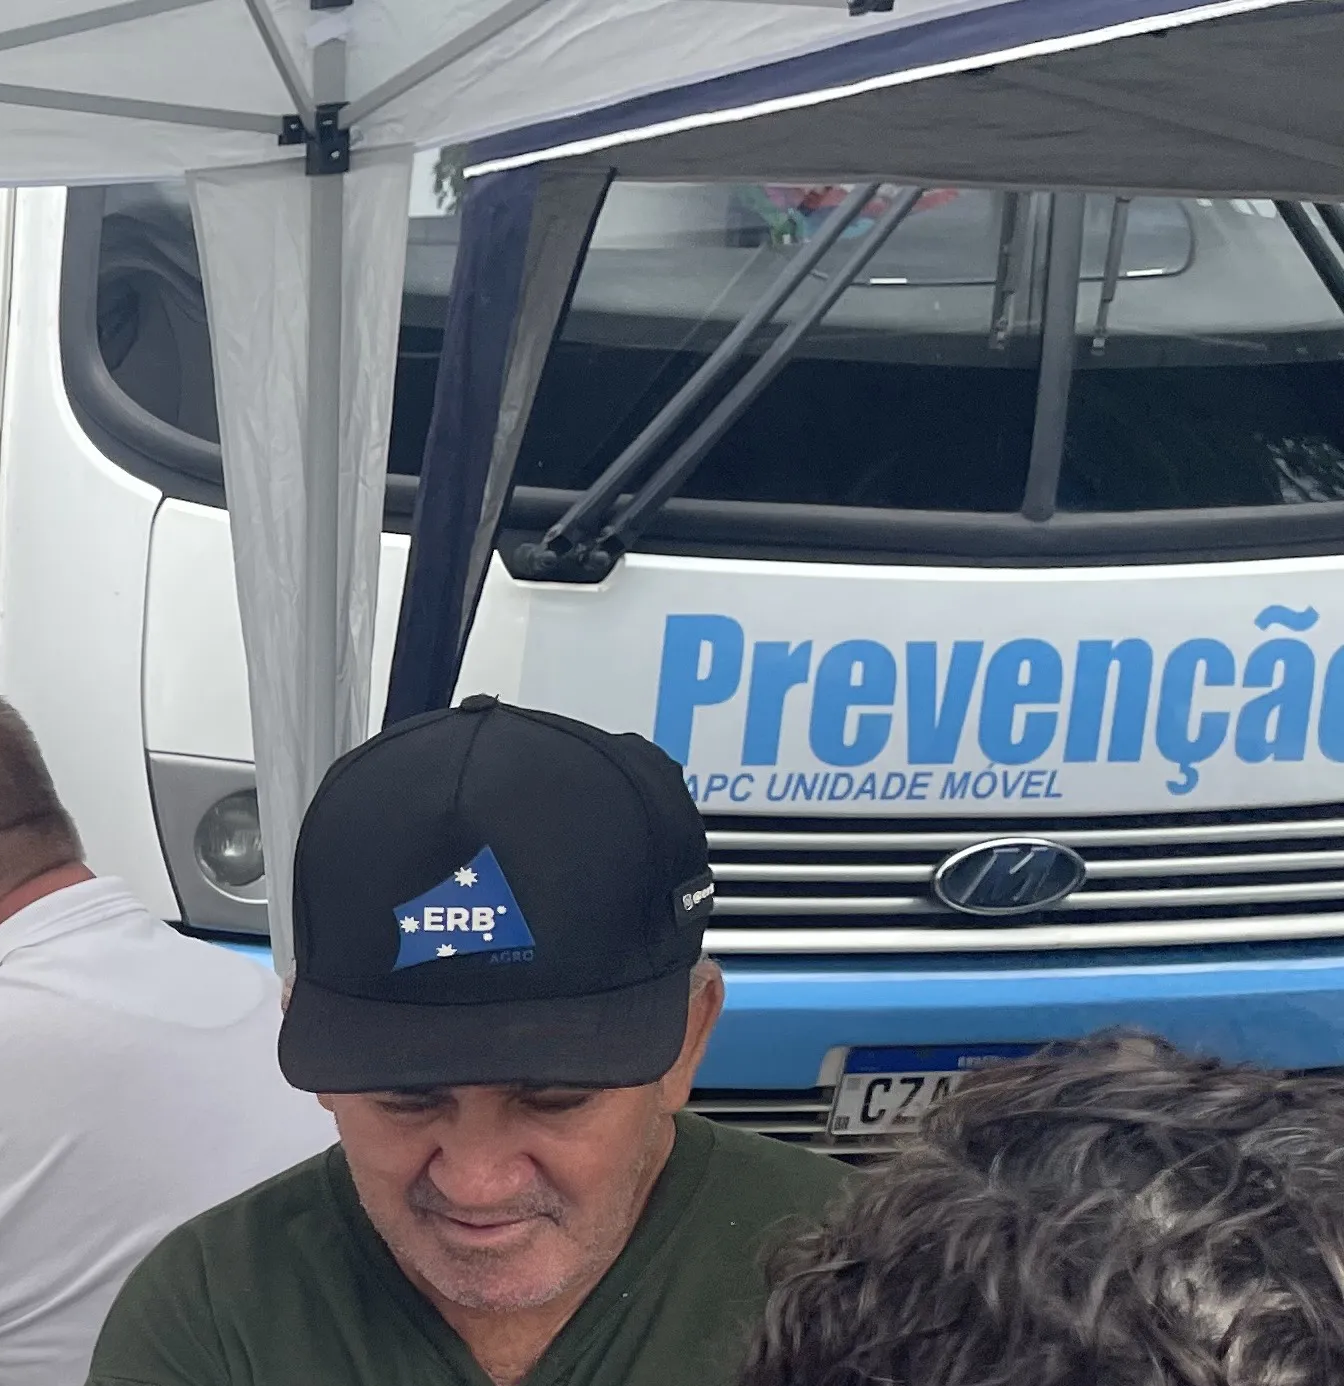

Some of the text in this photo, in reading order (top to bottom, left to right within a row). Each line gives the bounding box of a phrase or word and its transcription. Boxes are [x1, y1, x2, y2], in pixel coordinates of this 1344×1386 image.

[766, 770, 929, 801] UNIDADE
[938, 761, 1064, 800] MÓVEL
[423, 906, 496, 932] ERB
